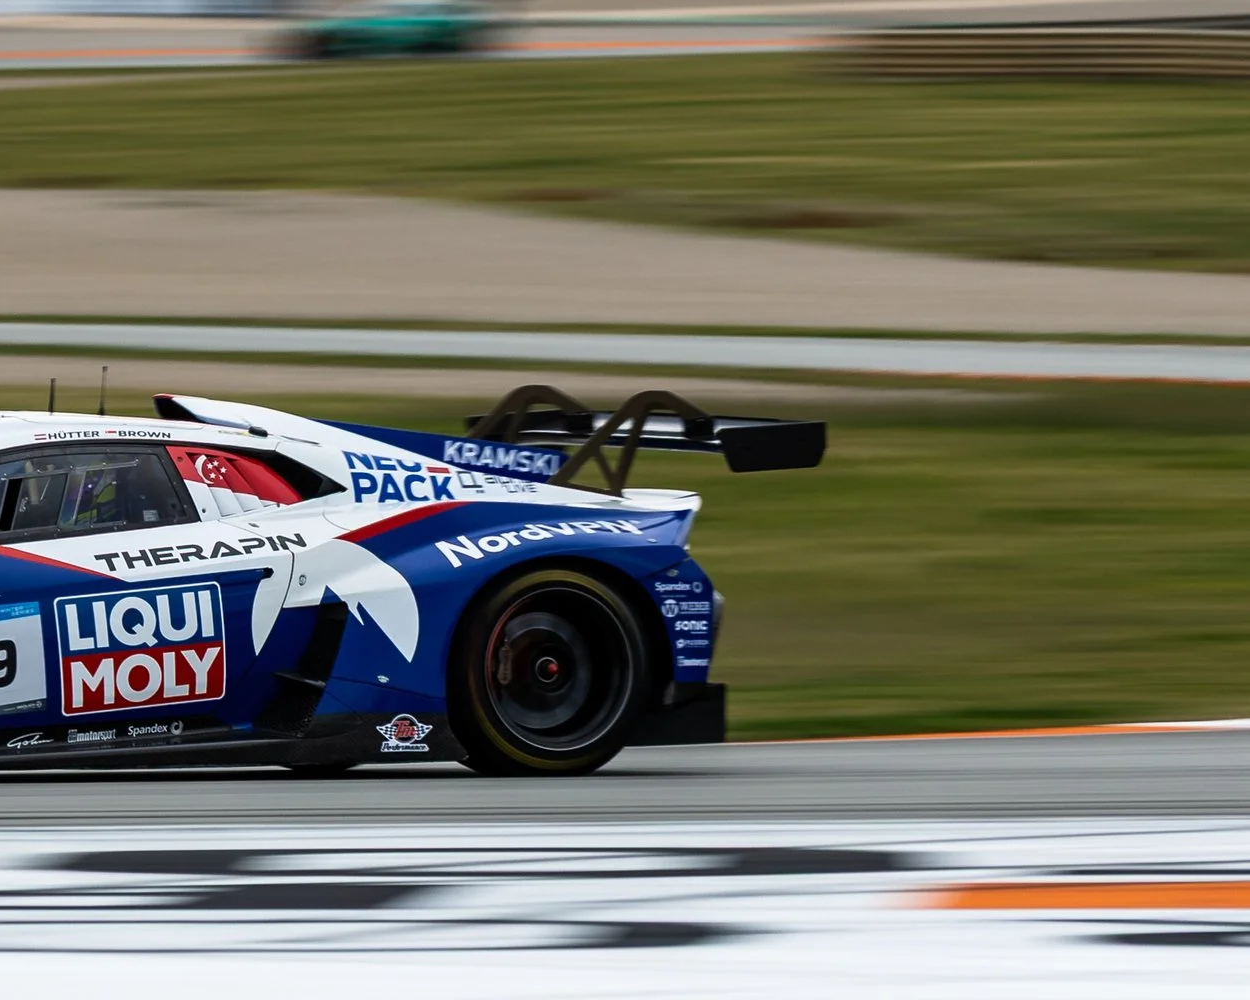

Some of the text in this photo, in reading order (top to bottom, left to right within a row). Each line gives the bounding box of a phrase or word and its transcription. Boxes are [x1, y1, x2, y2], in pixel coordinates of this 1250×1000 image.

[48, 430, 100, 440] HÜTTER
[119, 430, 171, 439] BROWN
[443, 440, 561, 476] KRAMSKI
[350, 471, 456, 503] PACK
[94, 533, 308, 572] THERAPIN
[435, 519, 644, 568] NordVPN
[65, 590, 215, 650] LIQUI
[70, 646, 221, 708] MOLY
[128, 724, 168, 737] Spandex
